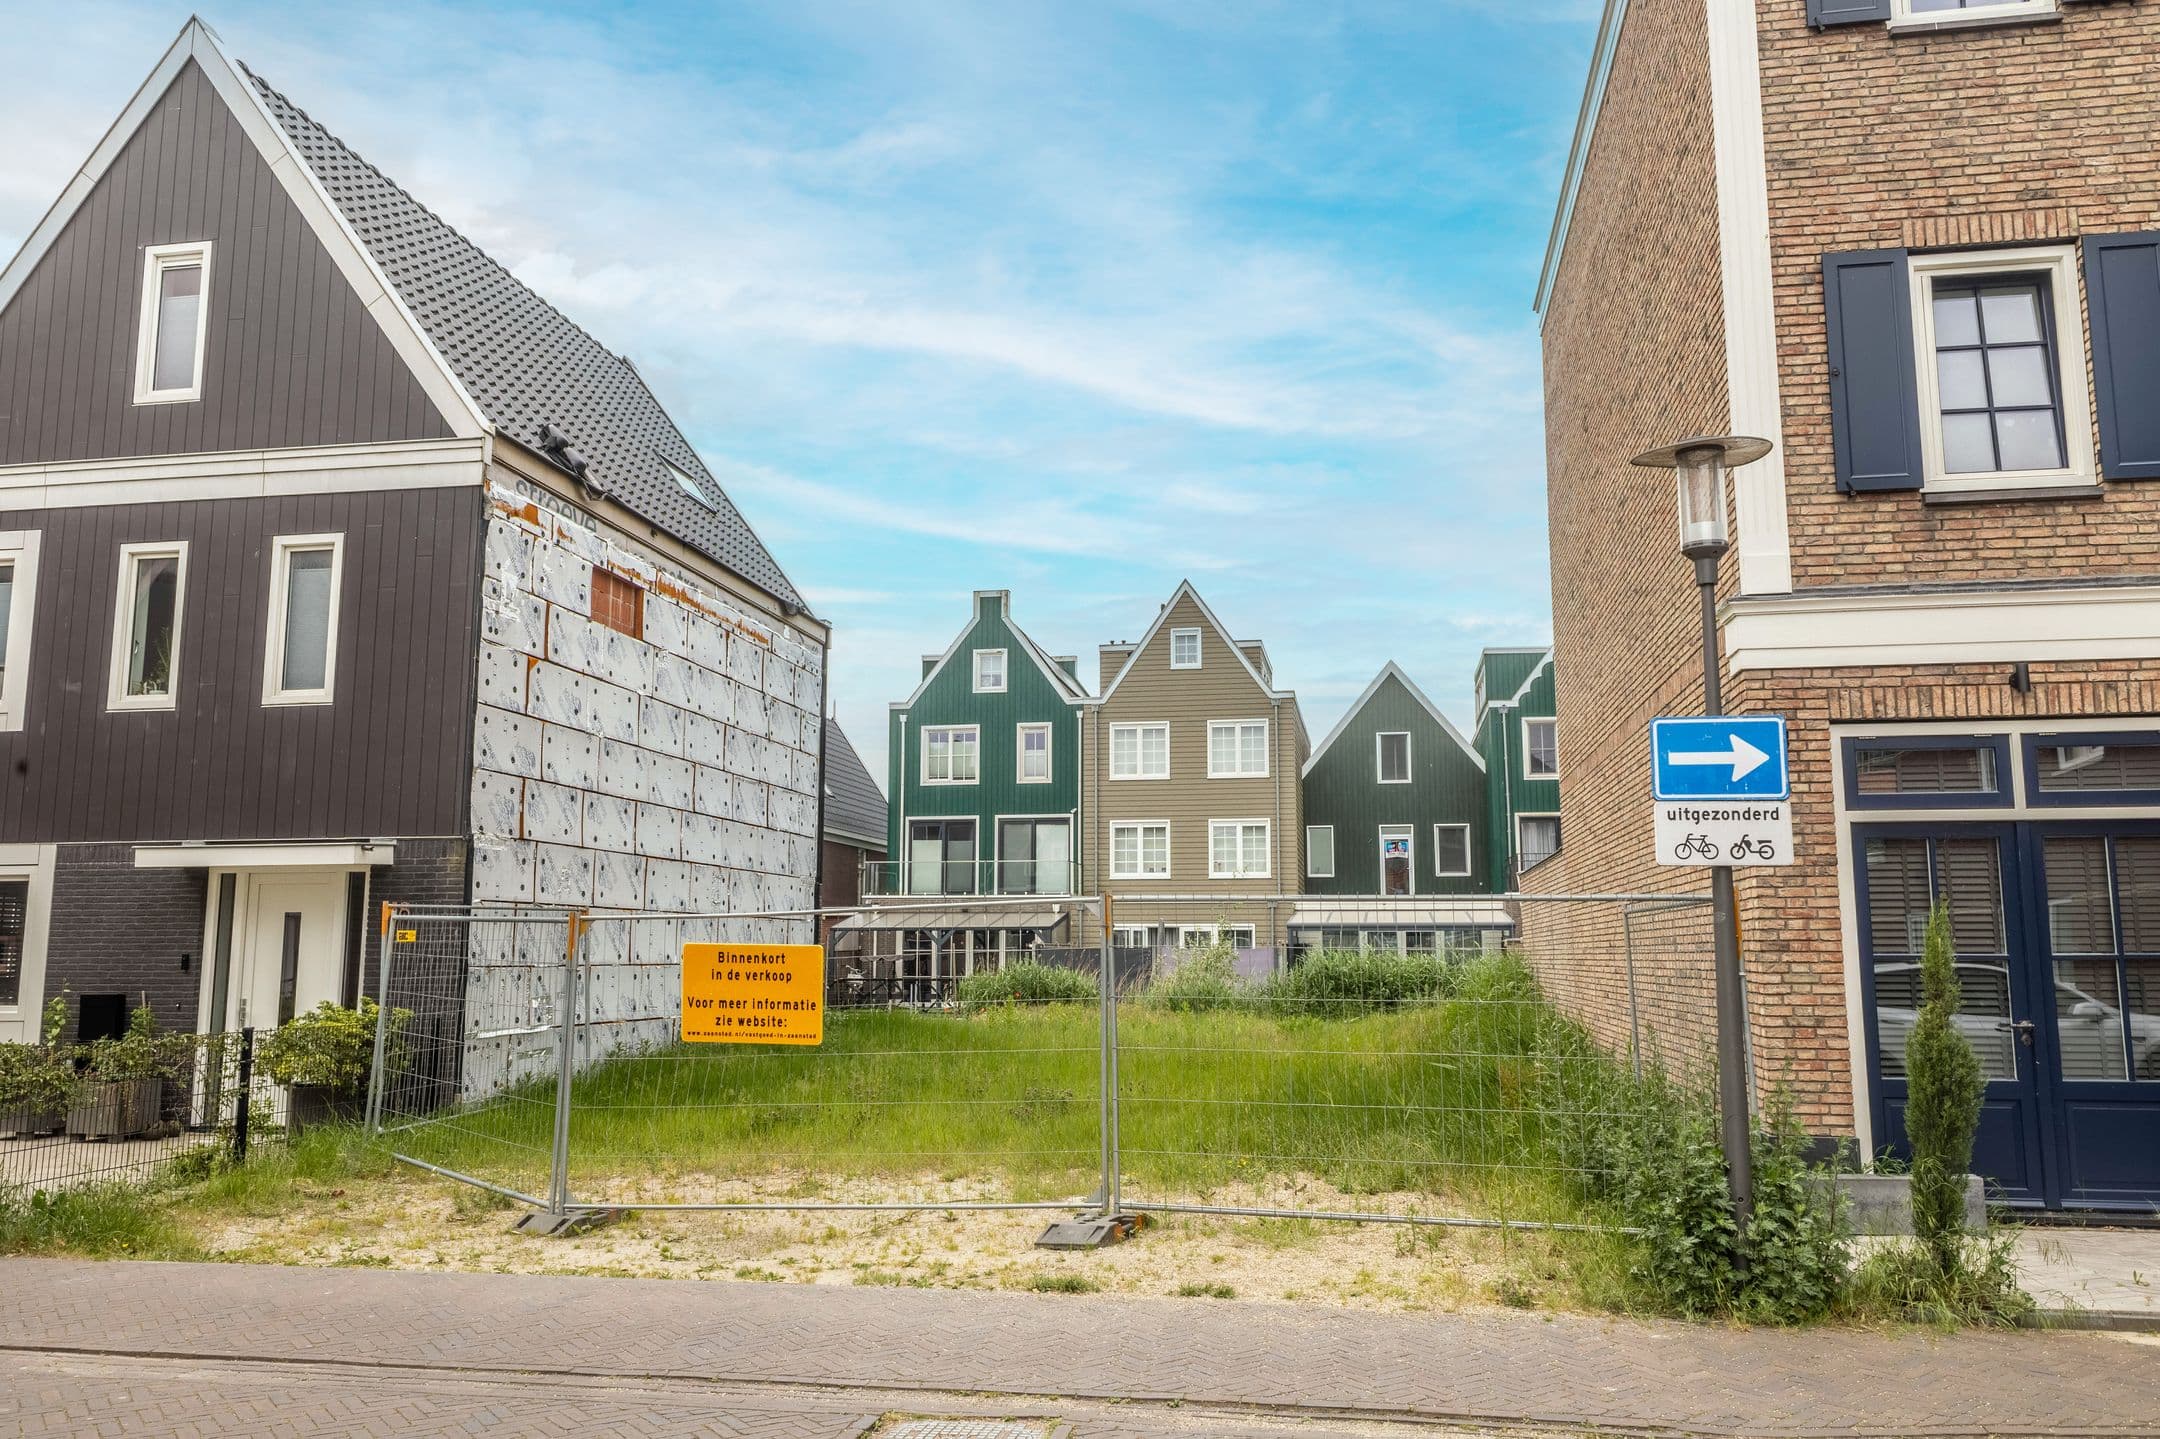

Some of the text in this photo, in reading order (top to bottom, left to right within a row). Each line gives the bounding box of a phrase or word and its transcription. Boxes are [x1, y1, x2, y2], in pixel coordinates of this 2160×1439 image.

[1667, 806, 1780, 825] uitgezonderd
[718, 951, 786, 964] Binnenkort
[711, 969, 792, 983] in de verkoop
[687, 997, 817, 1011] Voor meer informatie
[715, 1016, 787, 1027] zie website:
